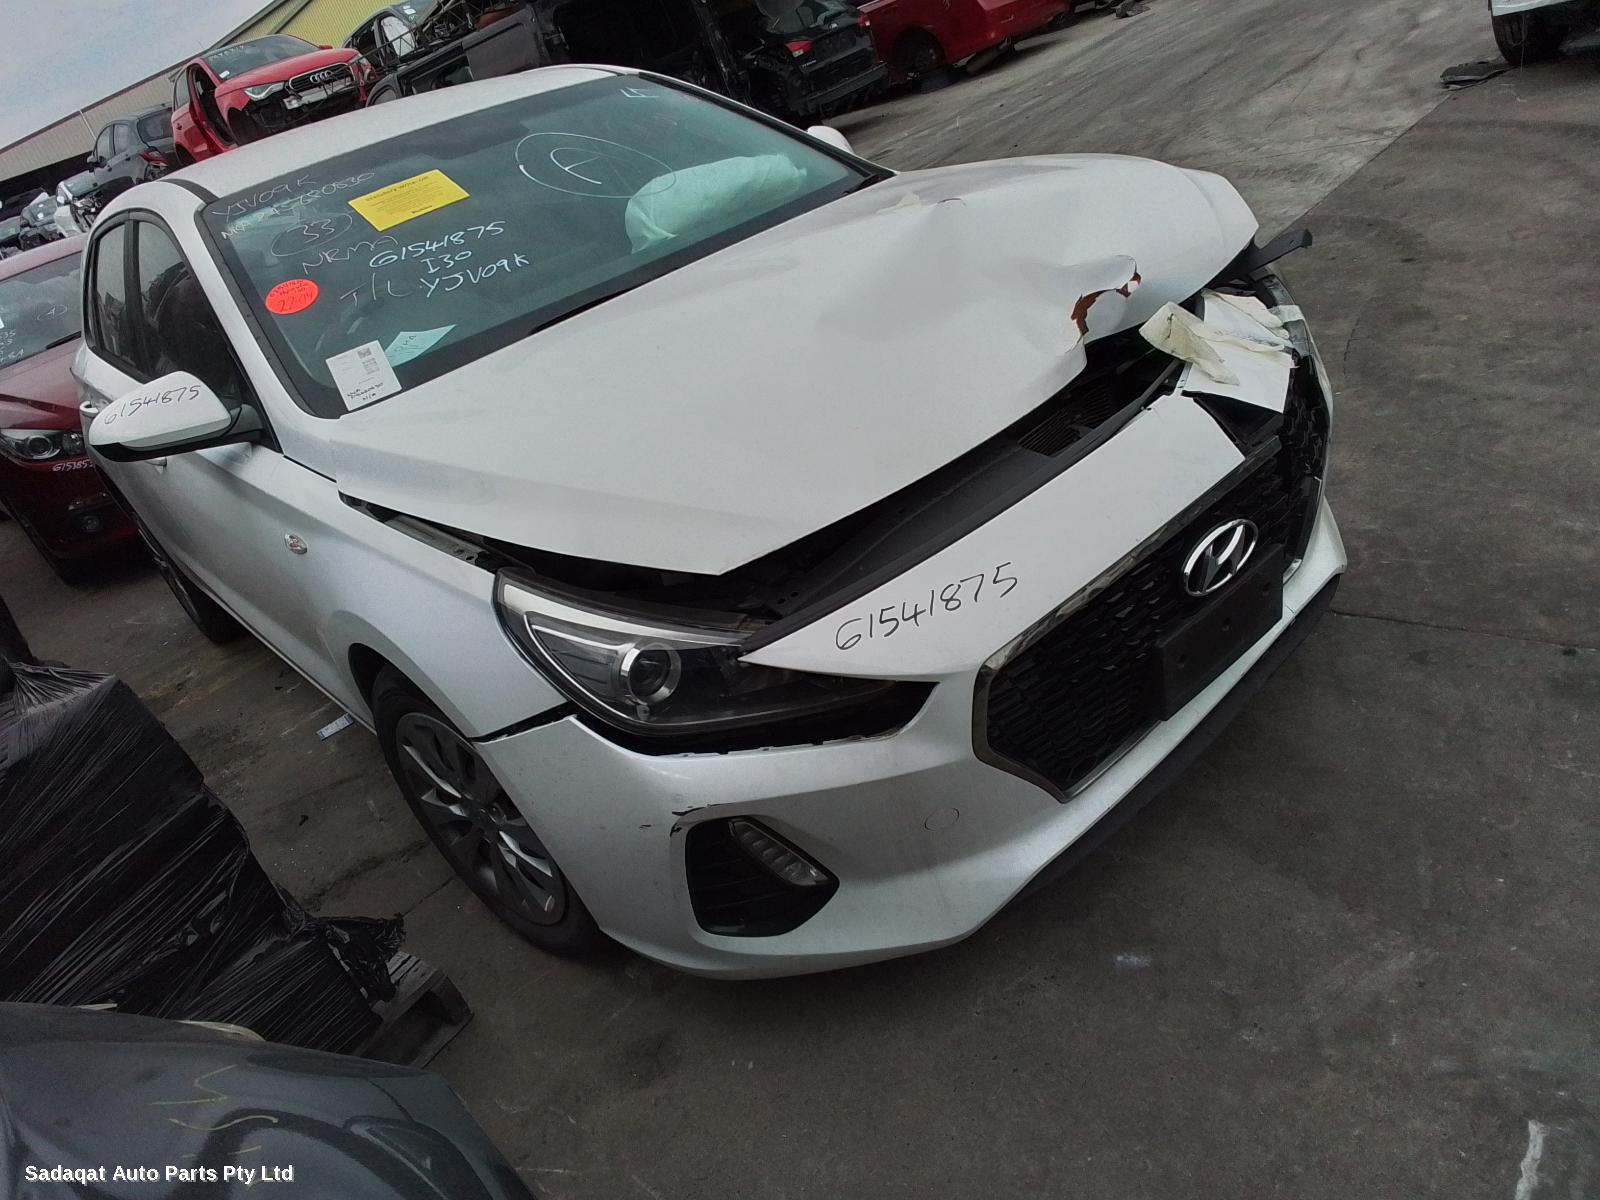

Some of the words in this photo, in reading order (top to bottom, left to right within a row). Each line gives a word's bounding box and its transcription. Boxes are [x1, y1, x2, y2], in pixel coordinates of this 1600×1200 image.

[212, 174, 316, 222] YJV09K
[287, 219, 335, 243] 33
[370, 221, 506, 268] 61541875
[420, 253, 530, 298] YJV09K
[104, 385, 201, 424] 61541875
[836, 562, 1018, 650] 61541875
